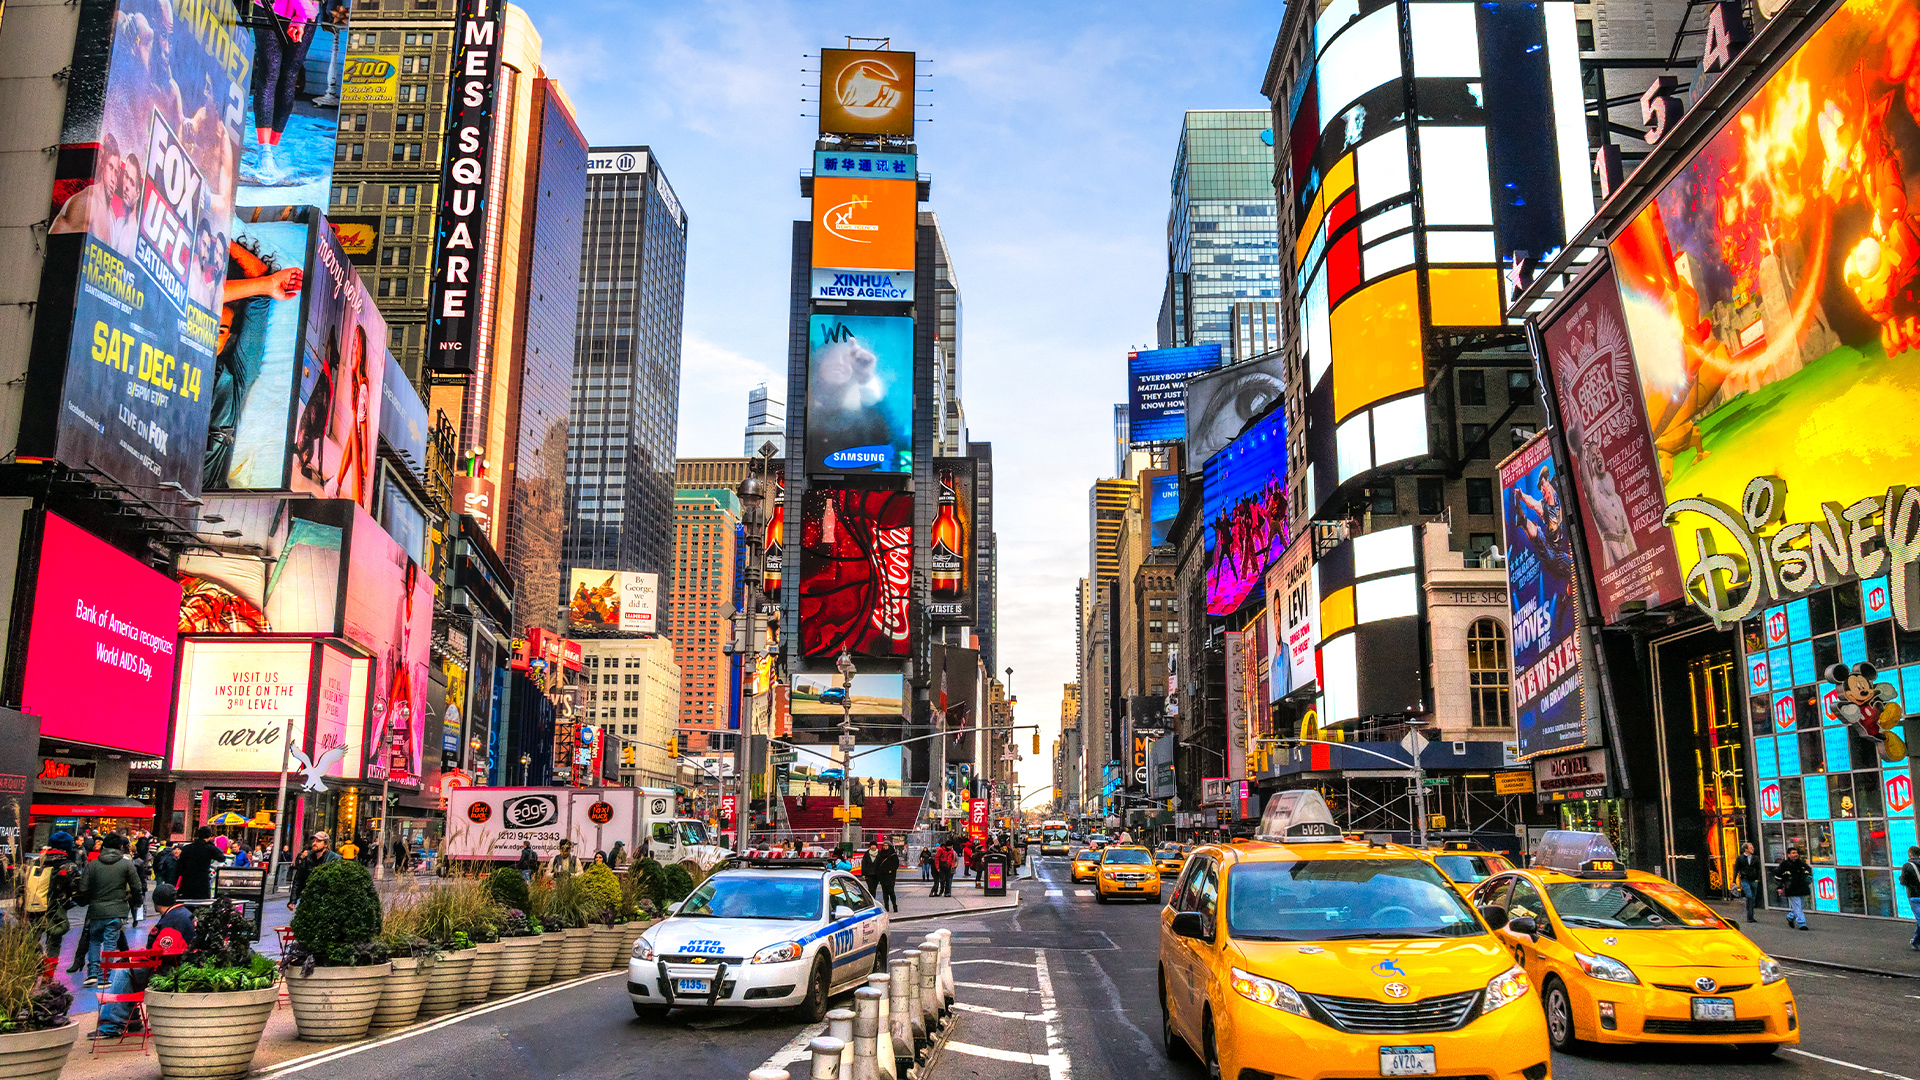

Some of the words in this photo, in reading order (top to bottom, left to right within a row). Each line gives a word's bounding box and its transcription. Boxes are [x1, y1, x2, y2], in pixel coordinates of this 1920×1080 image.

[225, 81, 246, 145] 2
[824, 158, 906, 173] 新华通讯社
[148, 129, 201, 231] FOX
[143, 189, 192, 276] UFC
[442, 126, 482, 318] SQUARE
[90, 244, 124, 278] FABER
[123, 269, 135, 287] VS
[136, 240, 186, 306] SATURDAY
[318, 235, 344, 299] merry
[87, 262, 144, 310] McDONALD
[833, 273, 893, 288] XINHUA
[820, 286, 854, 297] NEWS
[857, 287, 907, 298] AGENCY
[186, 320, 216, 347] BROWN
[439, 342, 462, 350] NYC
[91, 320, 135, 375] SAT.
[138, 343, 177, 392] DEC.
[180, 363, 202, 402] 14
[1137, 382, 1170, 392] MATILDA
[1139, 373, 1186, 382] "EVERYBODY
[1579, 362, 1608, 406] GREAT
[127, 381, 150, 402] 8/5PM
[1581, 381, 1615, 426] COMET
[119, 403, 137, 431] LIVE
[137, 419, 148, 440] ON
[148, 419, 168, 456] FOX
[833, 452, 885, 462] SAMSUNG
[1621, 440, 1636, 463] TALK
[1636, 434, 1643, 449] OF
[1615, 464, 1628, 479] THE
[1631, 492, 1659, 517] ORIGINAL
[1638, 561, 1653, 575] STREET
[625, 583, 653, 594] George,
[635, 576, 644, 585] By
[628, 600, 640, 608] did
[1288, 580, 1308, 629] LEVI
[1453, 592, 1476, 603] THE
[1513, 595, 1537, 629] NOTHING
[76, 599, 97, 624] Bank
[98, 610, 109, 628] of
[108, 613, 138, 640] America
[139, 630, 173, 655] recognizes
[1514, 600, 1551, 657] MOVES
[1538, 631, 1551, 653] LIKE
[96, 641, 119, 666] World
[119, 651, 138, 672] AIDS
[139, 657, 152, 682] Day.
[1515, 631, 1580, 708] NEWSIES
[232, 672, 260, 682] VISIT
[265, 672, 278, 682] US
[215, 685, 251, 696] INSIDE
[255, 685, 270, 696] ON
[275, 685, 293, 696] THE
[1232, 641, 1245, 748] PALACE
[227, 699, 243, 709] 3RD
[248, 699, 278, 709] LEVEL
[1540, 695, 1549, 713] ON
[218, 721, 280, 746] aerie
[1551, 756, 1587, 776] DIGITAL
[1585, 789, 1602, 797] SONY
[514, 803, 547, 819] edge
[723, 798, 735, 819] tkts
[974, 801, 985, 823] tkts
[499, 831, 516, 840] (212)
[517, 832, 560, 840] 947-3343
[1592, 861, 1613, 870] 7L66
[678, 946, 725, 954] POLICE
[835, 928, 853, 957] NYPD
[680, 979, 701, 989] 4135
